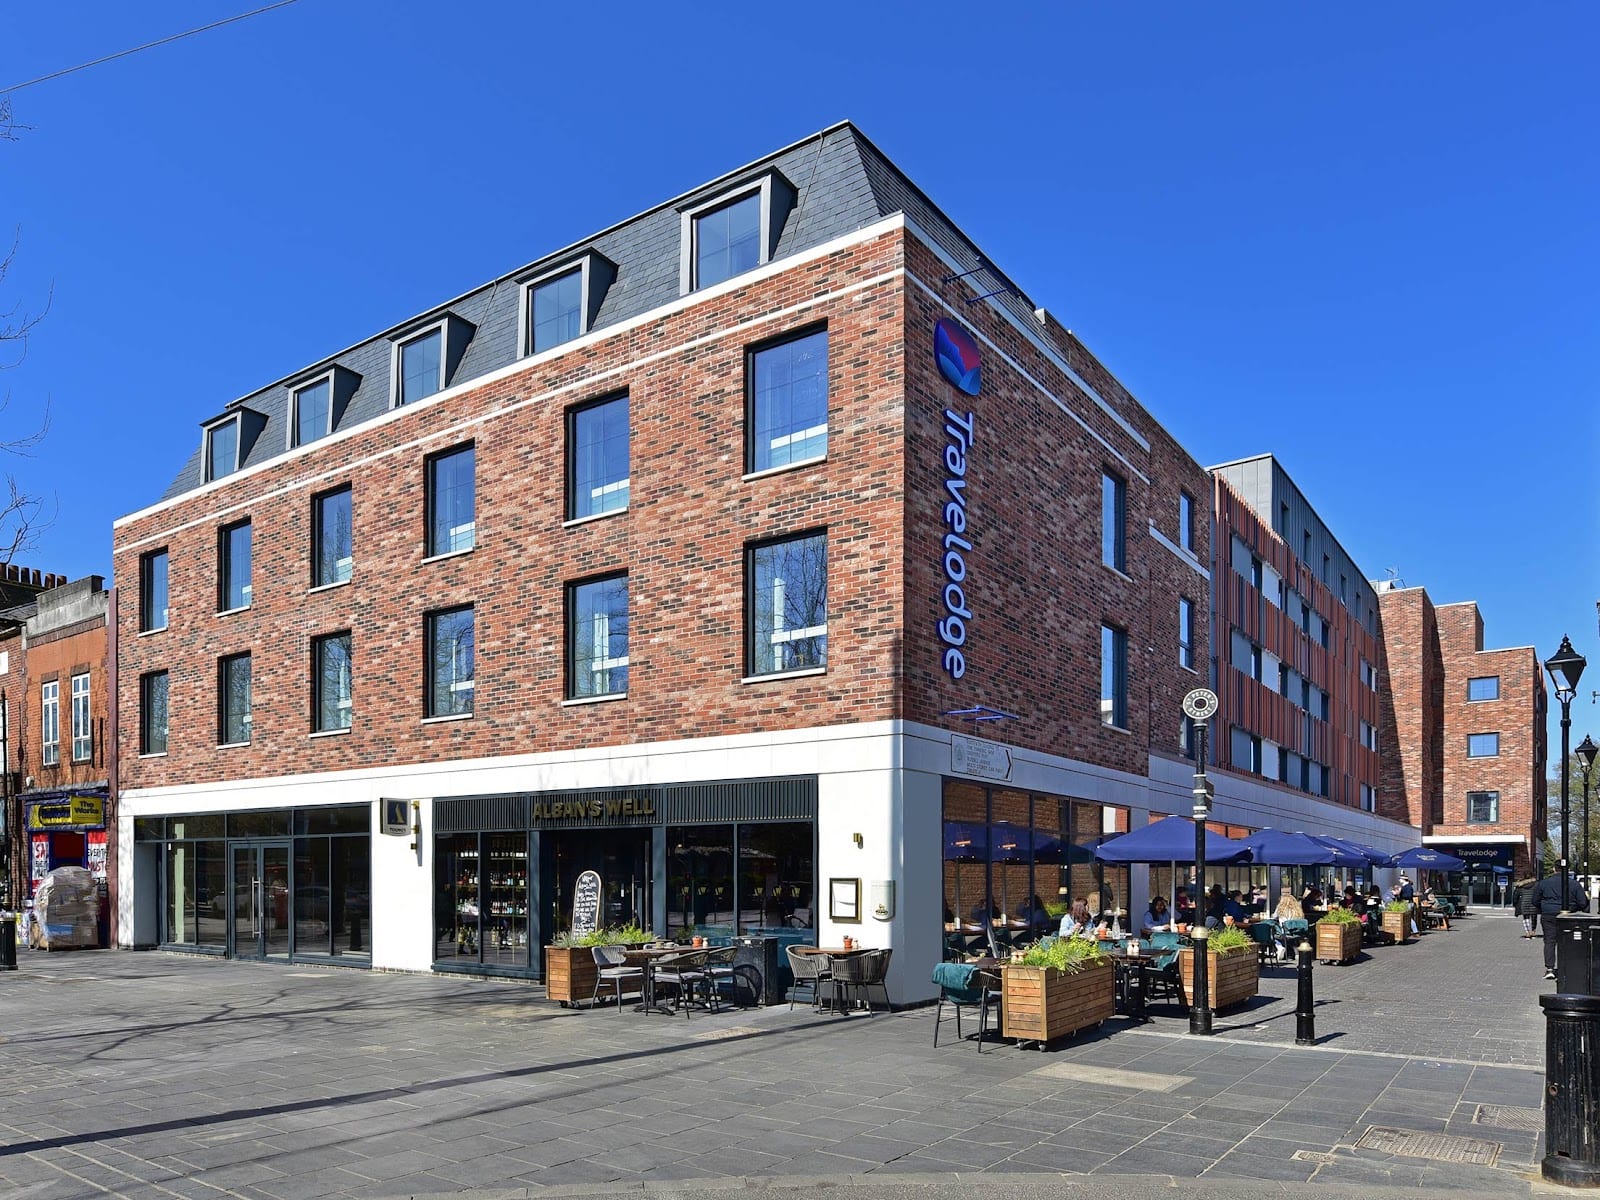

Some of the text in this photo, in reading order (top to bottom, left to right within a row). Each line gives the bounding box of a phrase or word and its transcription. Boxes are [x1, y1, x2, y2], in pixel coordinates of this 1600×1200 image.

[937, 409, 973, 679] Travelodge
[533, 798, 655, 818] ALBAN'S WELL
[1458, 849, 1498, 857] Travelodge
